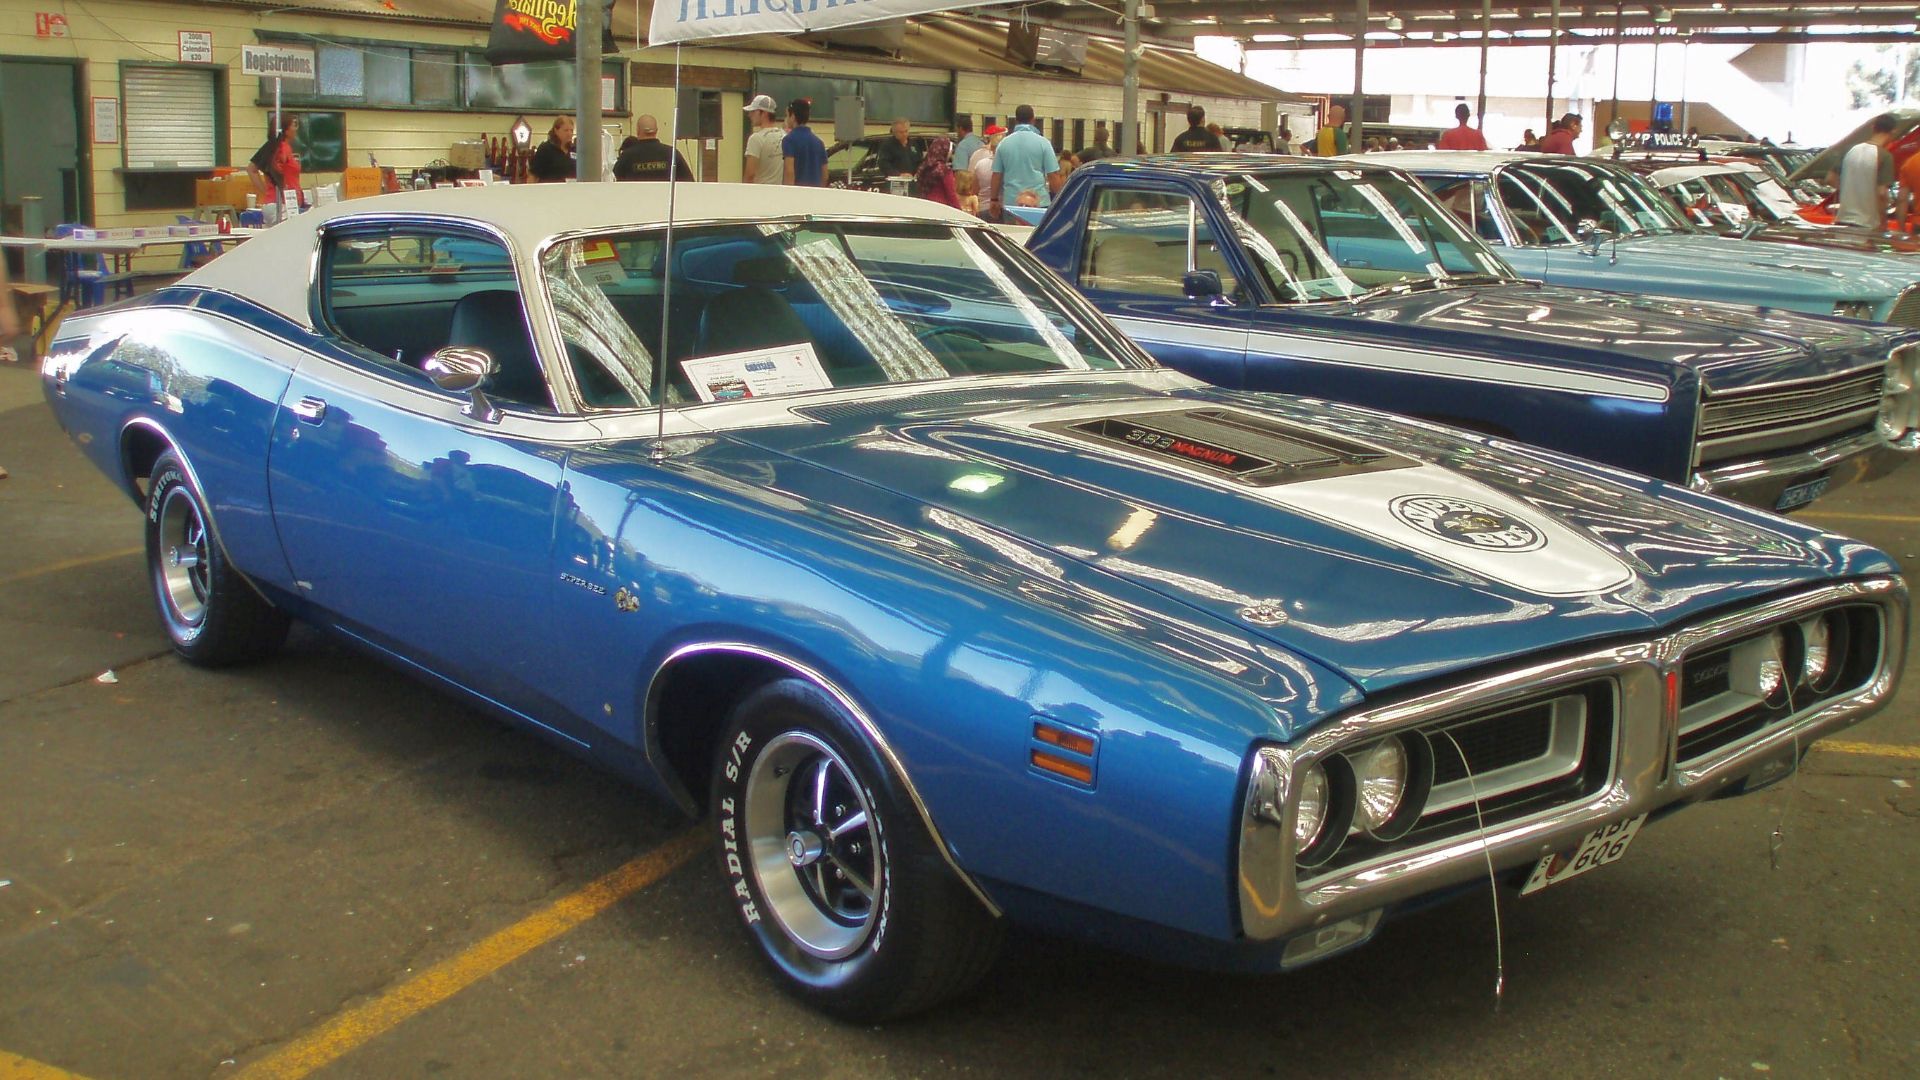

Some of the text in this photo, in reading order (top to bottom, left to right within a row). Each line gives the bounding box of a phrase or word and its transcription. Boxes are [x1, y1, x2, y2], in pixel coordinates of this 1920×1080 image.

[1654, 133, 1683, 146] POLICE
[1125, 429, 1237, 465] 383 MAGNUM
[1401, 499, 1505, 535] SUPER
[1462, 524, 1535, 547] BEE
[725, 730, 752, 783] S/R
[722, 797, 761, 925] RADIAL
[1573, 834, 1630, 870] 606
